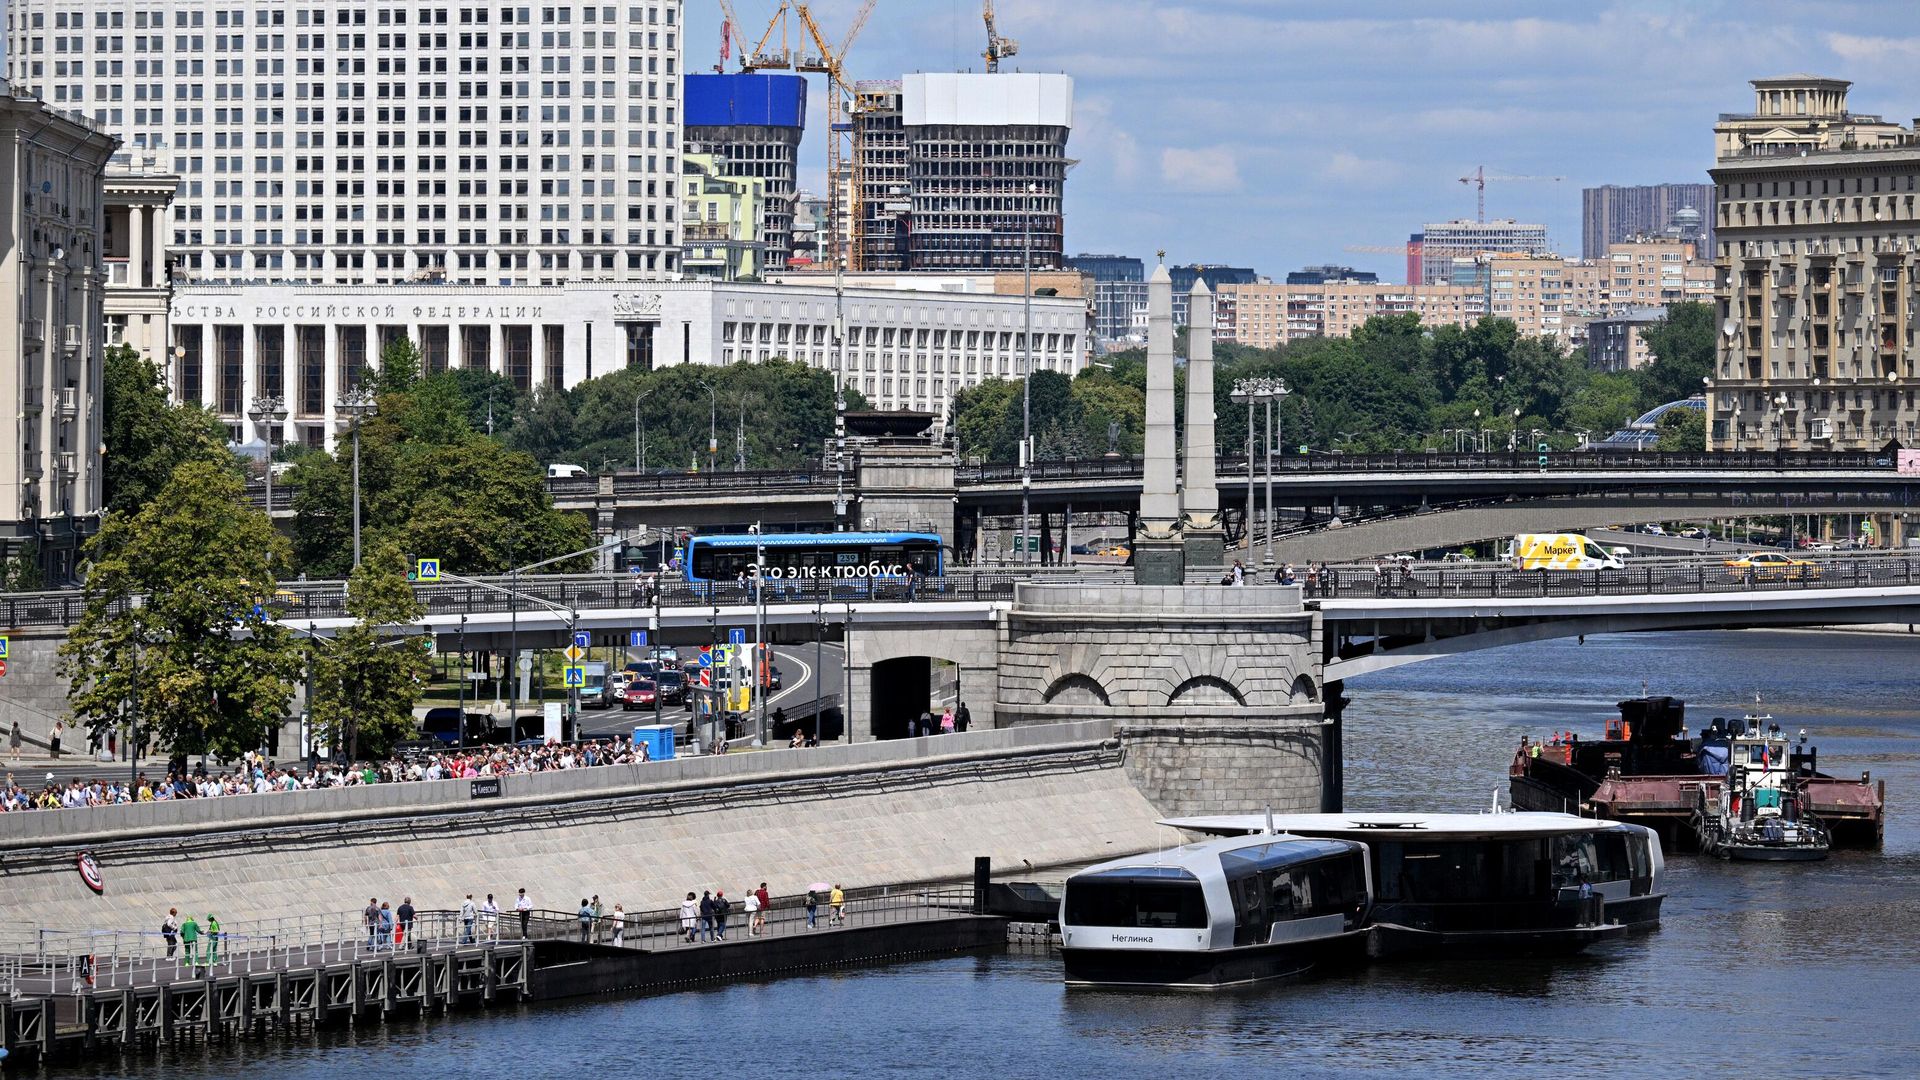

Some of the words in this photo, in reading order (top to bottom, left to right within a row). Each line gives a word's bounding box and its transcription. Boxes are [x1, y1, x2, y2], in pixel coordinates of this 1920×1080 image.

[255, 304, 394, 318] РОССИЙСКОЙ
[412, 306, 542, 318] ФЕДЕРАЦИИ
[1544, 546, 1577, 556] Маркет
[839, 554, 856, 563] 239
[747, 563, 783, 579] Это
[1112, 934, 1153, 943] Неглинка
